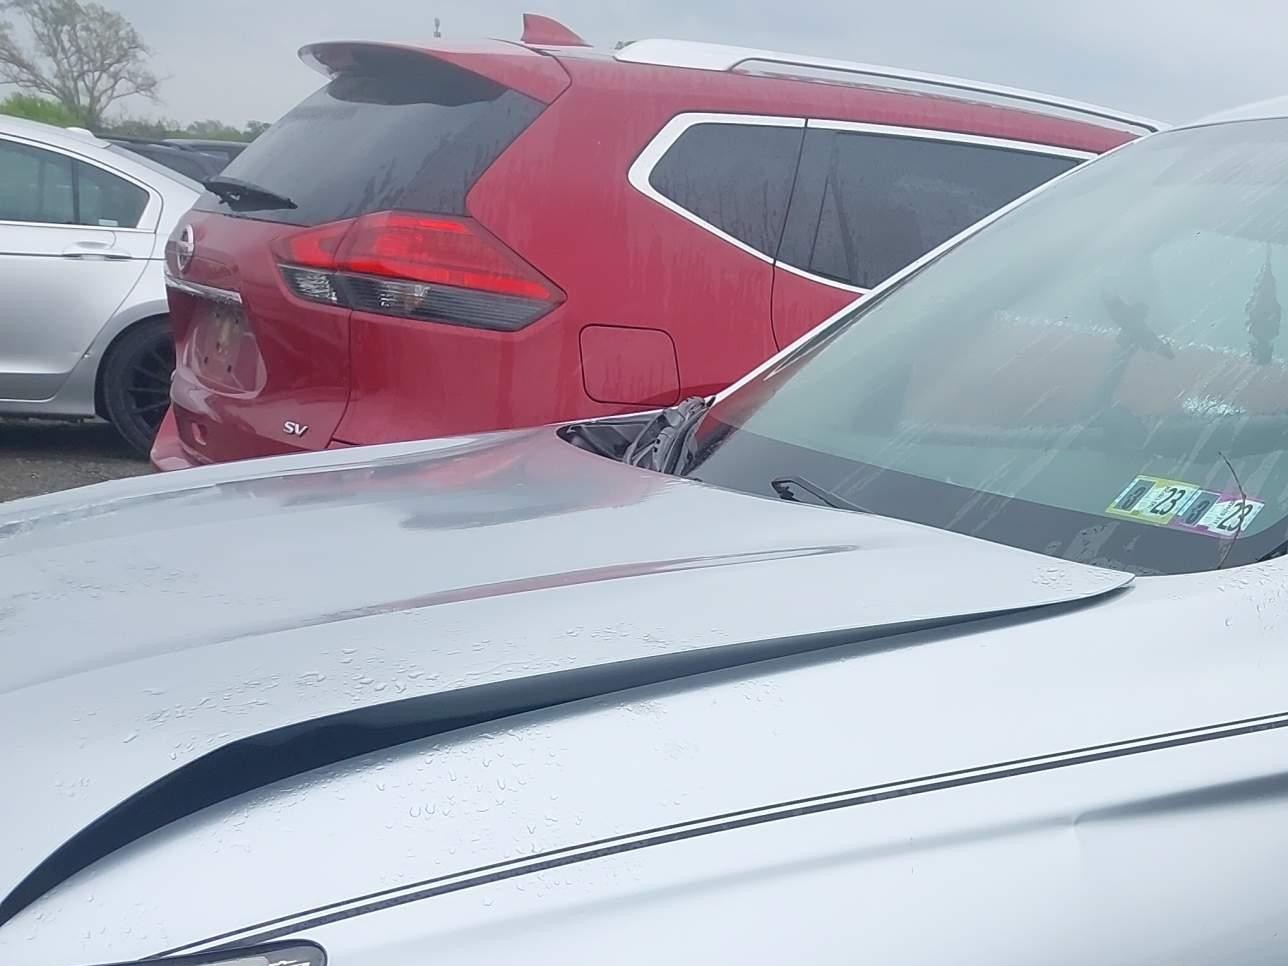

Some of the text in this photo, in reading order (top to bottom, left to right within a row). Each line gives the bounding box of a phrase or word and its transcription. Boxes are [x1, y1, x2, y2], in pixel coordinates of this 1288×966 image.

[283, 421, 308, 436] SV
[1150, 487, 1186, 515] 23
[1216, 502, 1253, 531] 23
